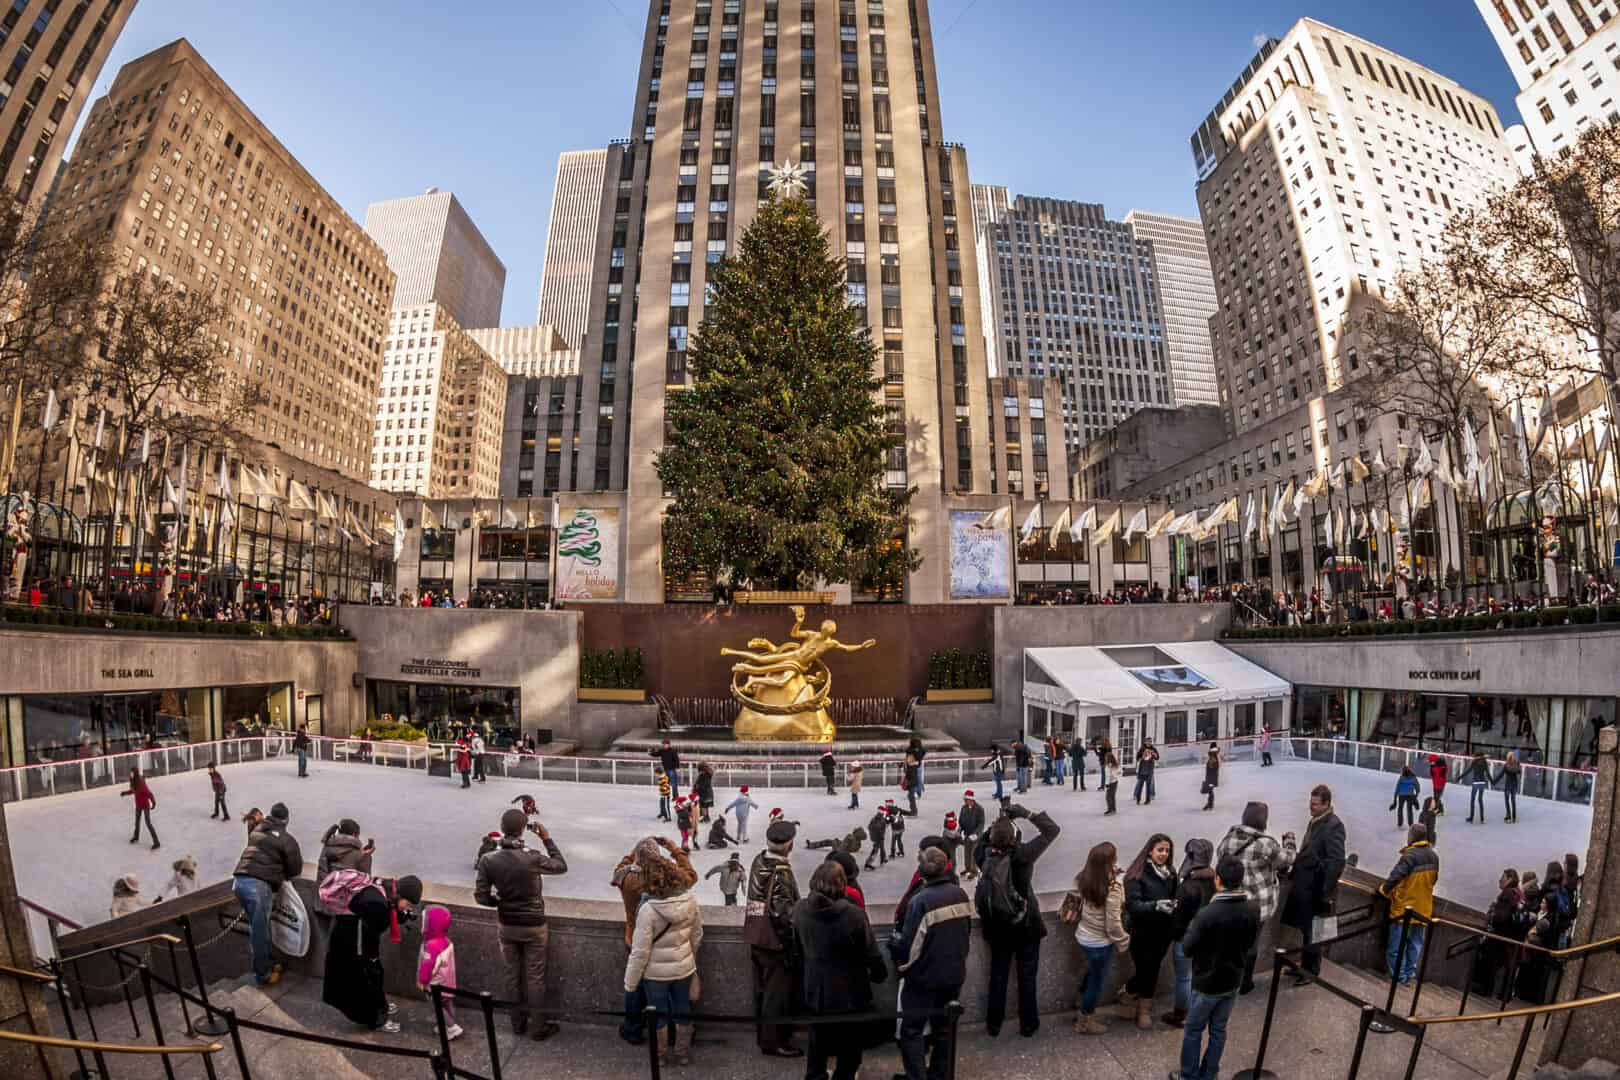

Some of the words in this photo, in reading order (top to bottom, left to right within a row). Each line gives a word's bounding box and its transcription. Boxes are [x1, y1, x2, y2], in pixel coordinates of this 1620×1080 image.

[411, 658, 424, 666] THE
[425, 658, 468, 668] CONCOURSE
[101, 669, 115, 678] THE
[118, 669, 132, 678] SEA
[134, 669, 154, 678] GRILL
[400, 667, 449, 676] ROCKEFELLER
[451, 669, 481, 678] CENTER
[1409, 671, 1428, 680] ROCK
[1430, 671, 1459, 680] CENTER
